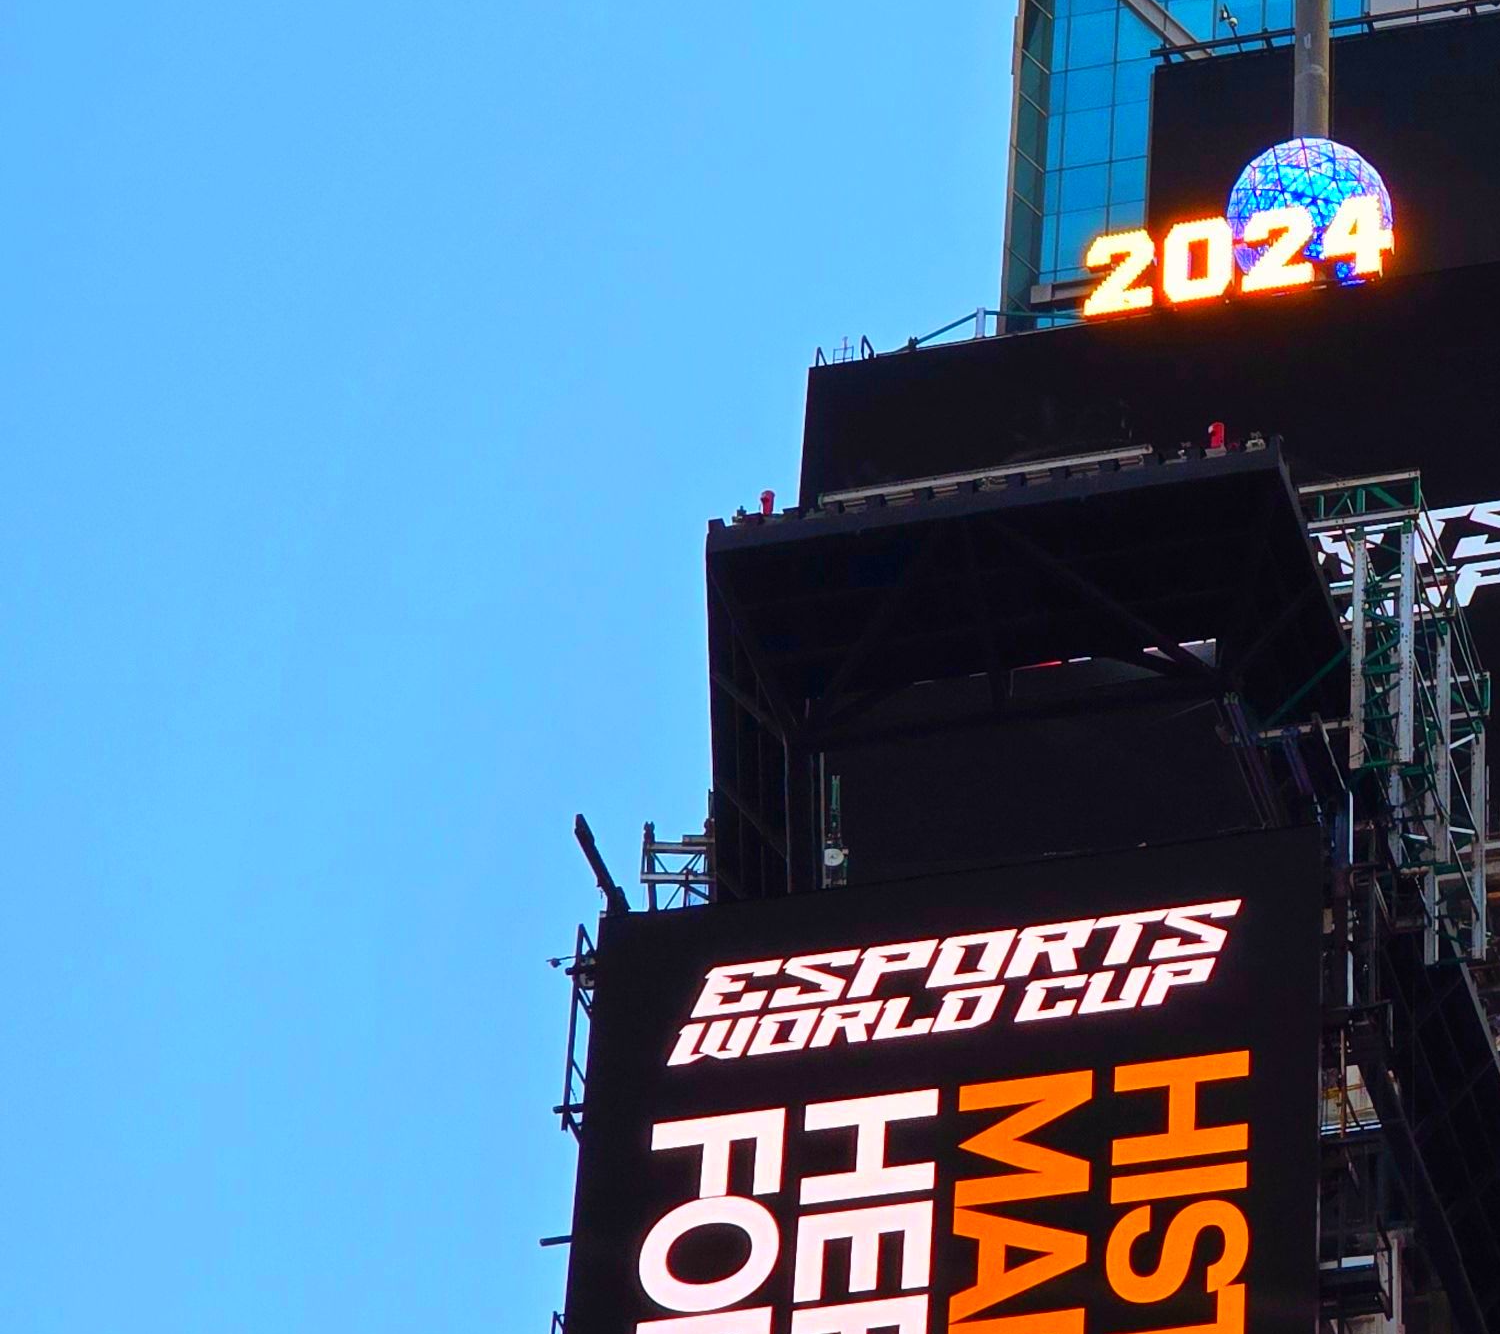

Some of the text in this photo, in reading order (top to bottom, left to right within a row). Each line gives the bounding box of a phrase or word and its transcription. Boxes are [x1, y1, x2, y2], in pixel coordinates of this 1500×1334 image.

[1083, 193, 1394, 317] 2024
[667, 957, 1216, 1066] WORLD CUP
[691, 899, 1241, 1018] ESPORTS
